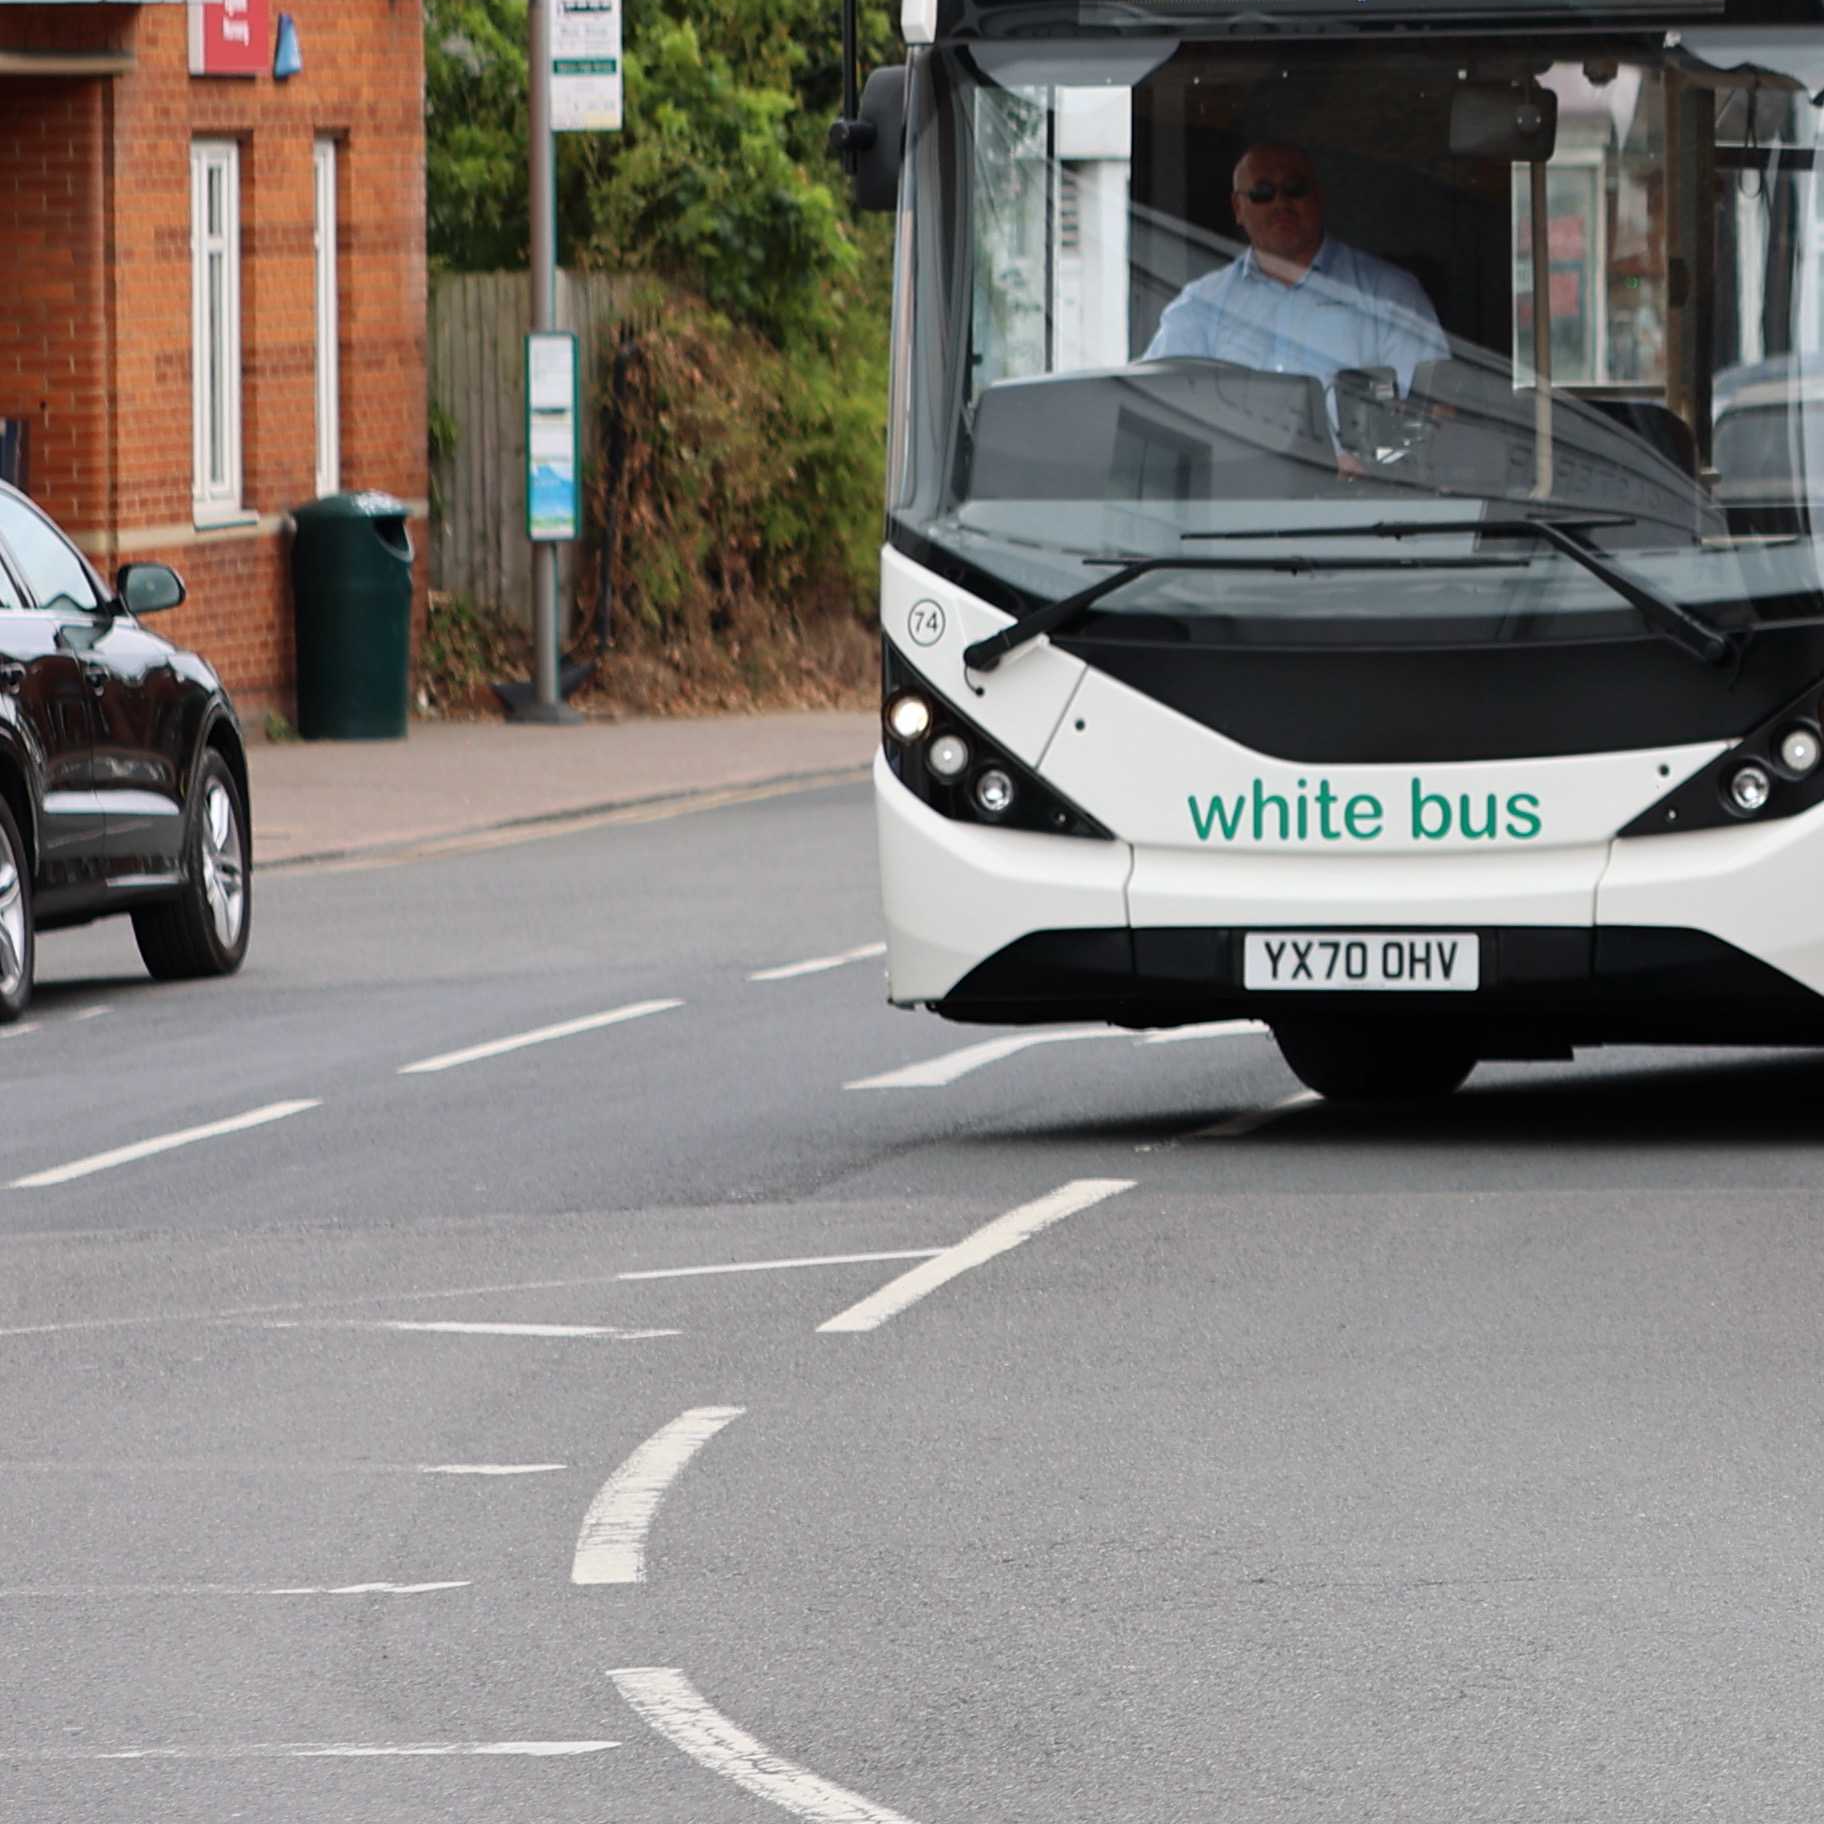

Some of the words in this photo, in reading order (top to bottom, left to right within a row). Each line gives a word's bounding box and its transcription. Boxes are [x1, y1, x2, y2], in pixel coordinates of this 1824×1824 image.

[915, 610, 938, 633] 74
[1187, 777, 1384, 841] white
[1411, 776, 1543, 841] bus
[1263, 940, 1369, 982] YX70
[1381, 940, 1459, 982] OHV
